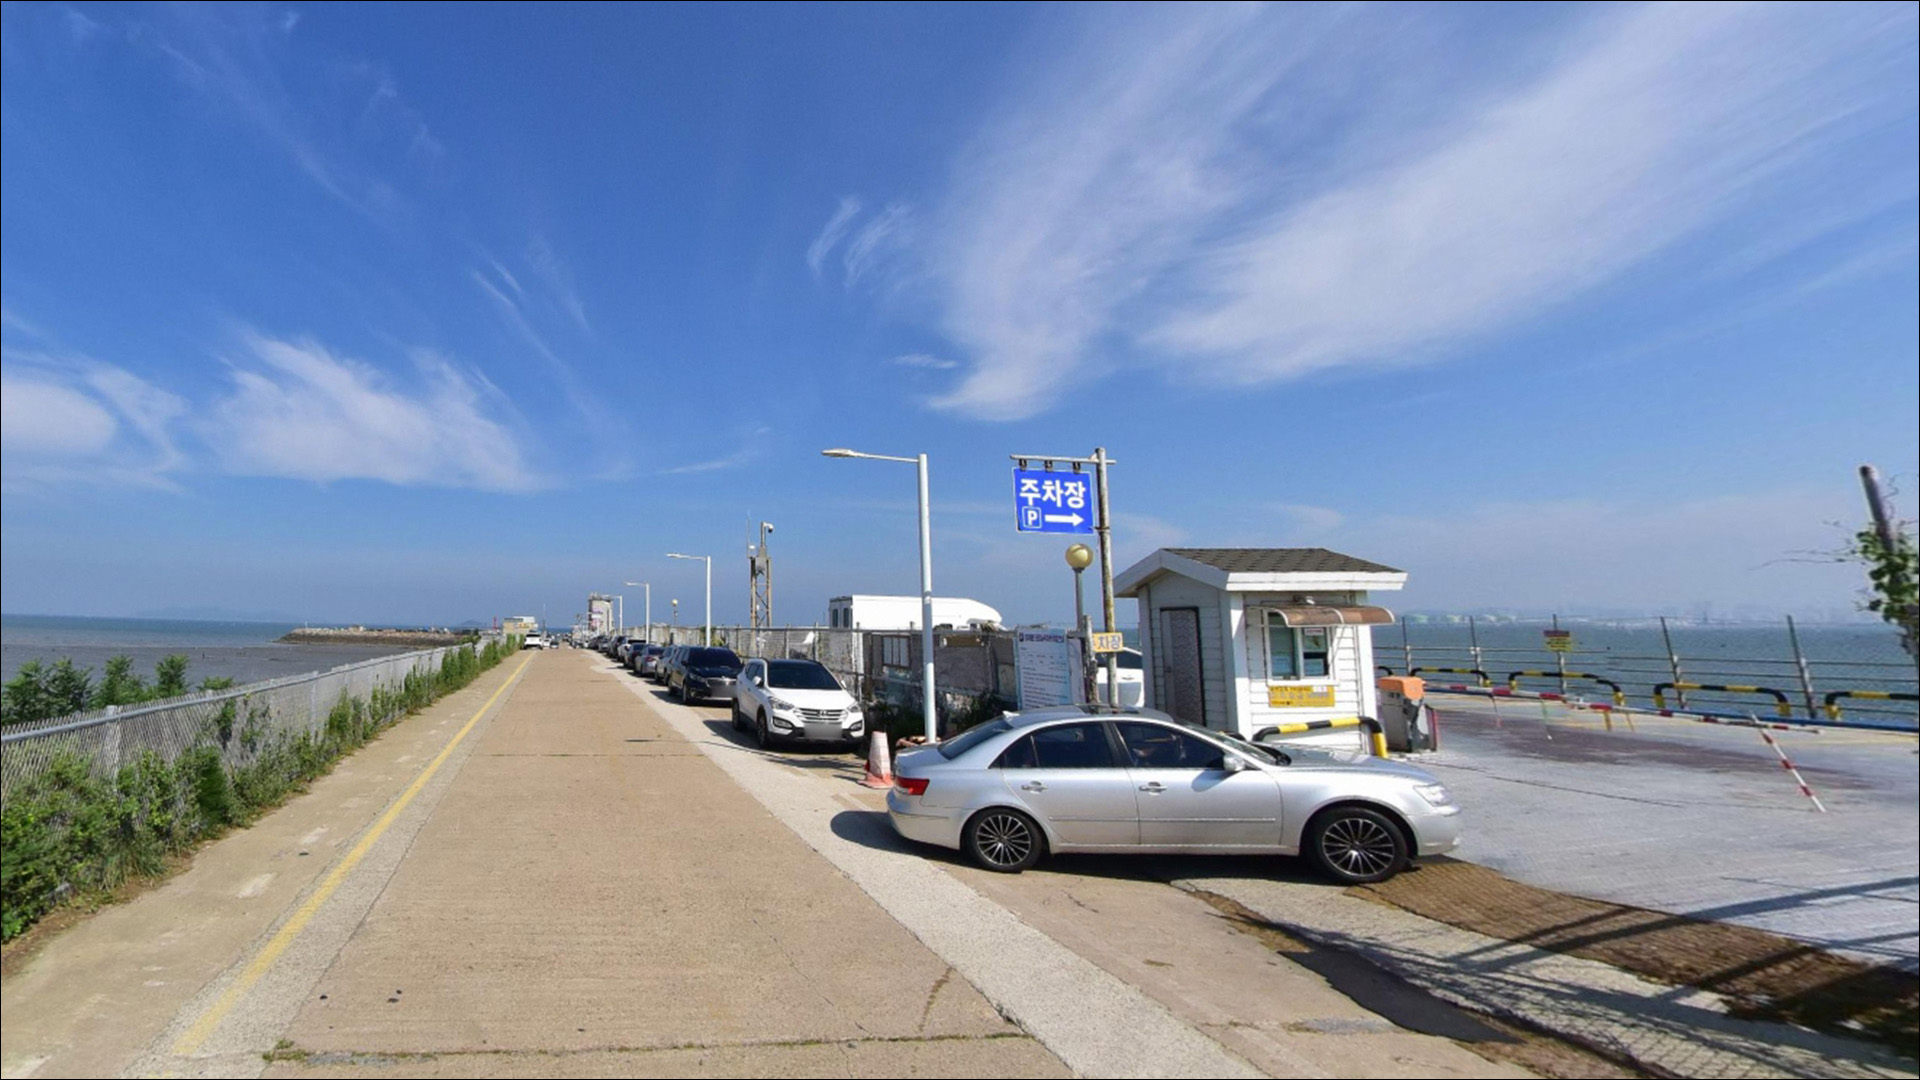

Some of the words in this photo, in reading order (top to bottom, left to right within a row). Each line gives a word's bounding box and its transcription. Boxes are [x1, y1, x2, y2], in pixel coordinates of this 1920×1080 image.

[1019, 478, 1086, 509] 주차장
[1027, 510, 1038, 526] P
[1092, 635, 1121, 650] 차장
